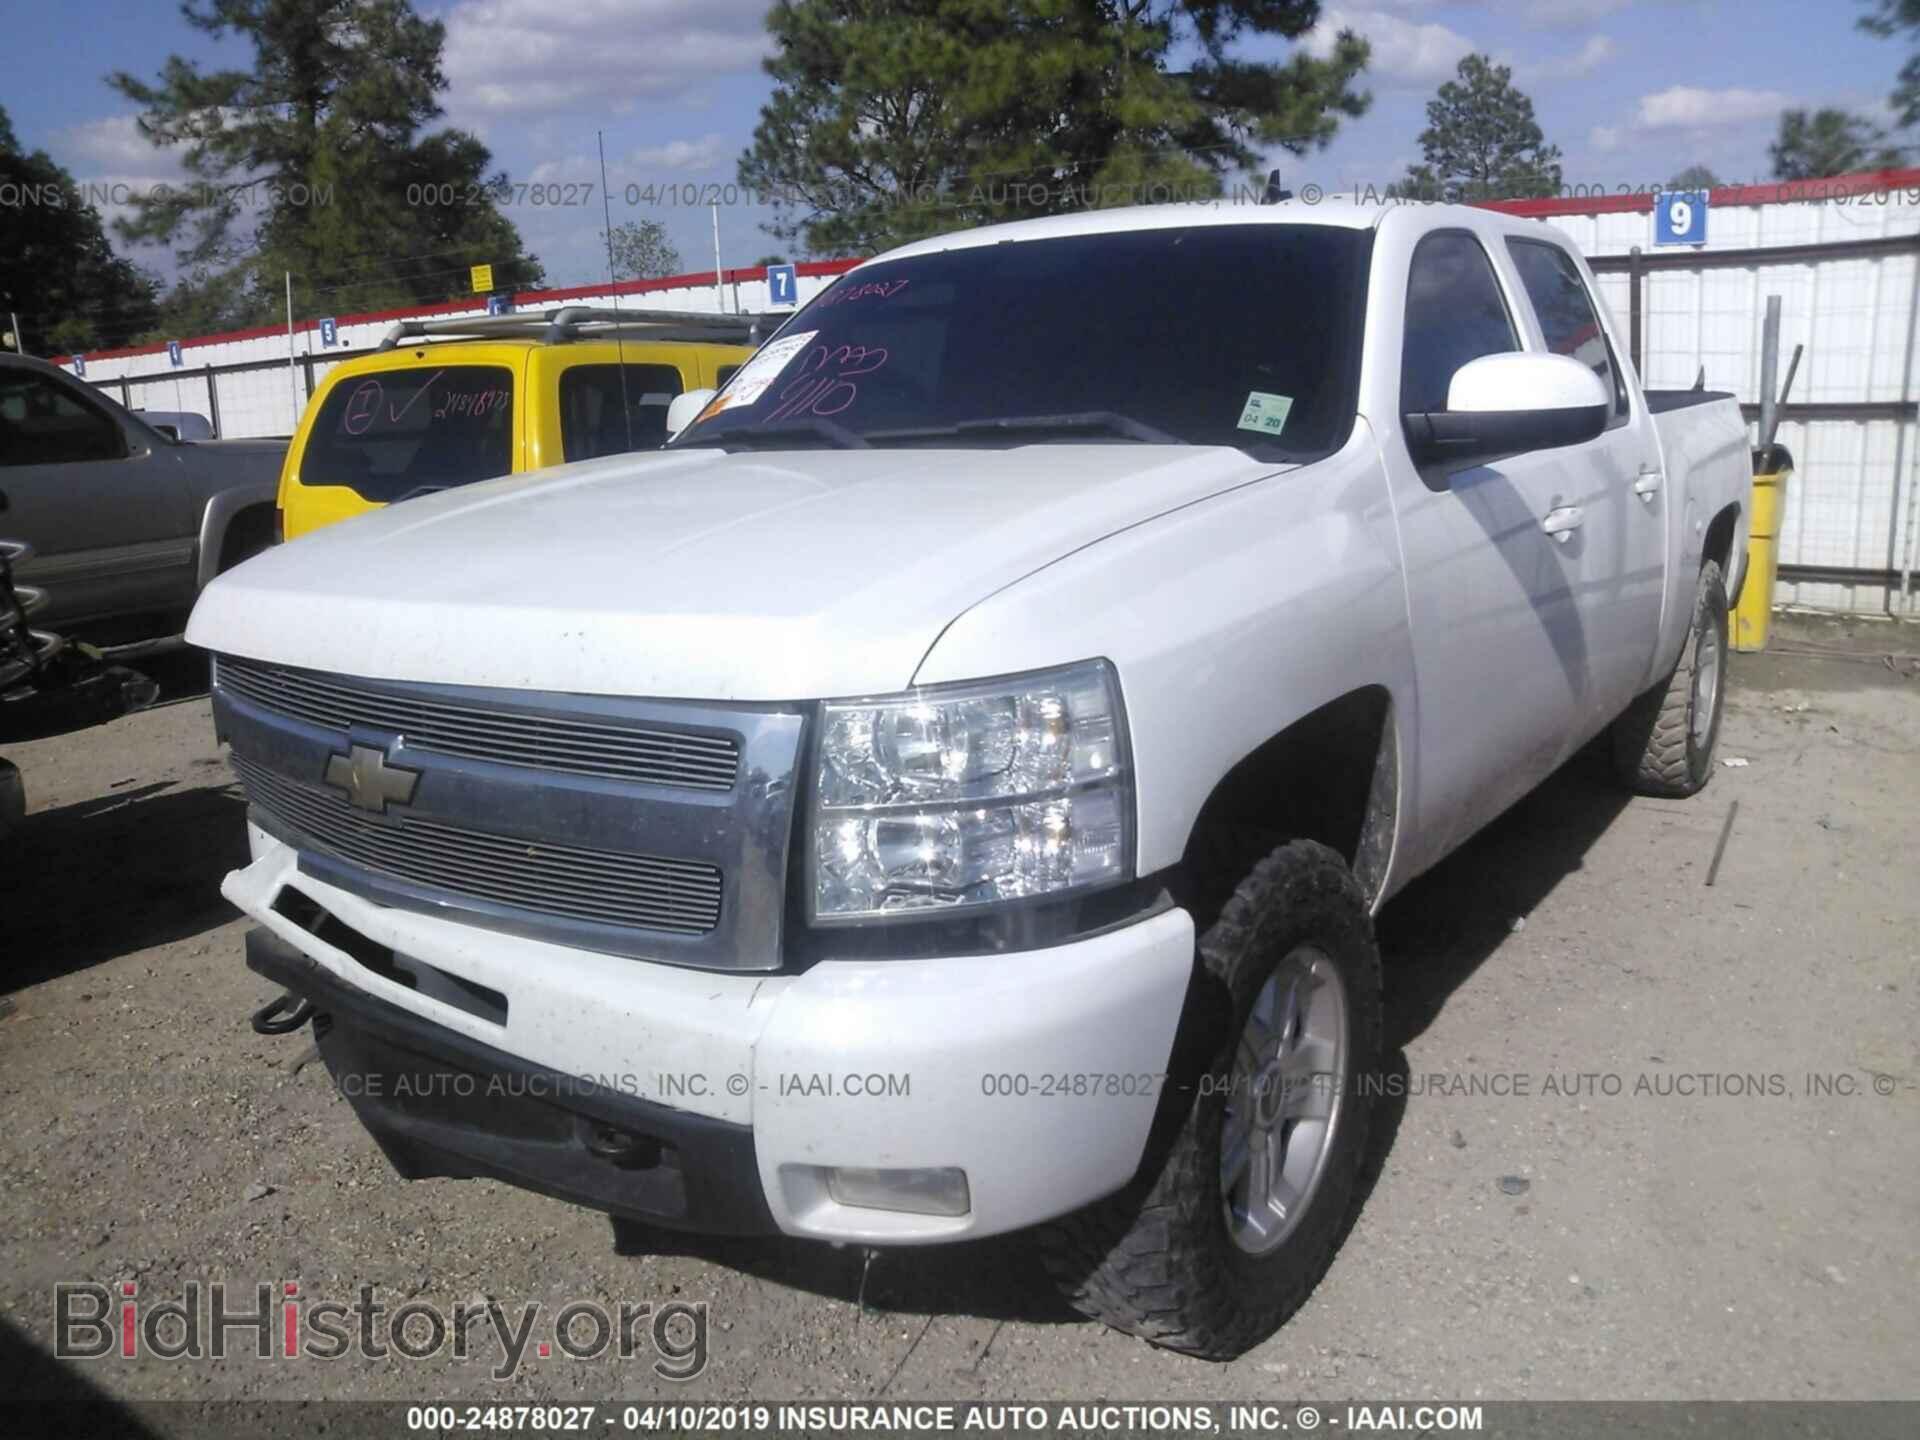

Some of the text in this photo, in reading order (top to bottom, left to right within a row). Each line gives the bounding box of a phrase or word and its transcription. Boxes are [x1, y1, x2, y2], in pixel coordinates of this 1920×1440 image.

[1670, 201, 1692, 236] 9
[775, 272, 787, 297] 7
[324, 322, 333, 341] 5
